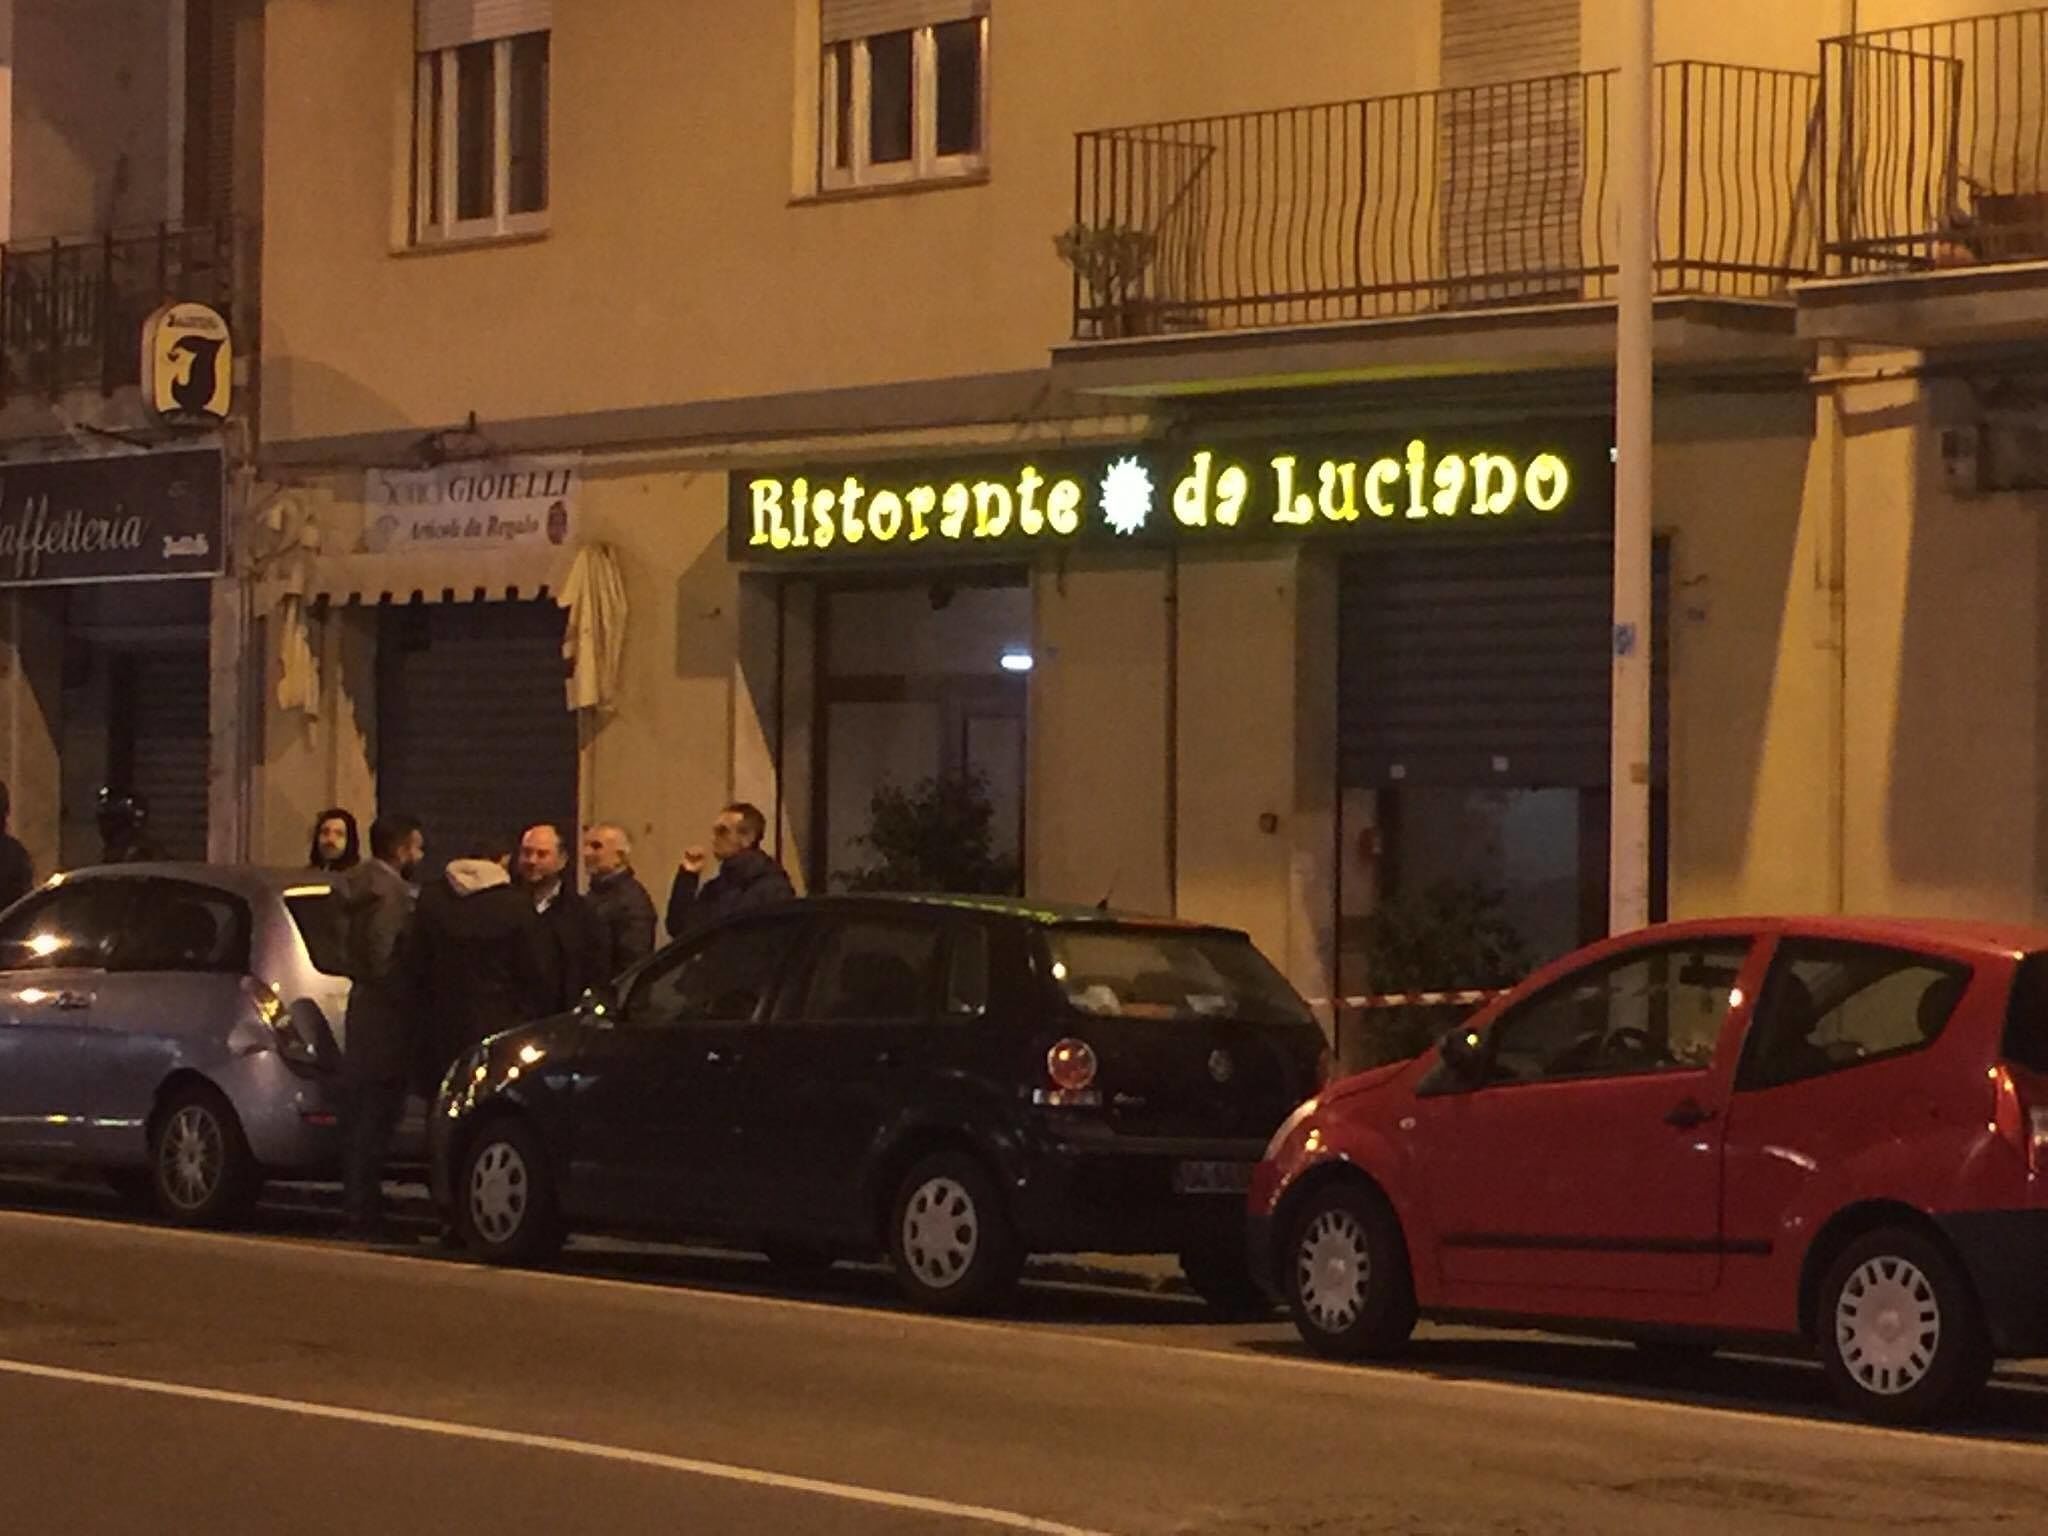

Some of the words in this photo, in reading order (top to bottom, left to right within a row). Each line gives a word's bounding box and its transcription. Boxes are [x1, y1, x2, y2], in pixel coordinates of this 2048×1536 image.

[0, 478, 145, 577] affetteria
[449, 469, 572, 503] GIOIELLI
[748, 465, 1082, 550] Ristorante
[1173, 450, 1248, 527] da
[1270, 439, 1570, 525] Luciano
